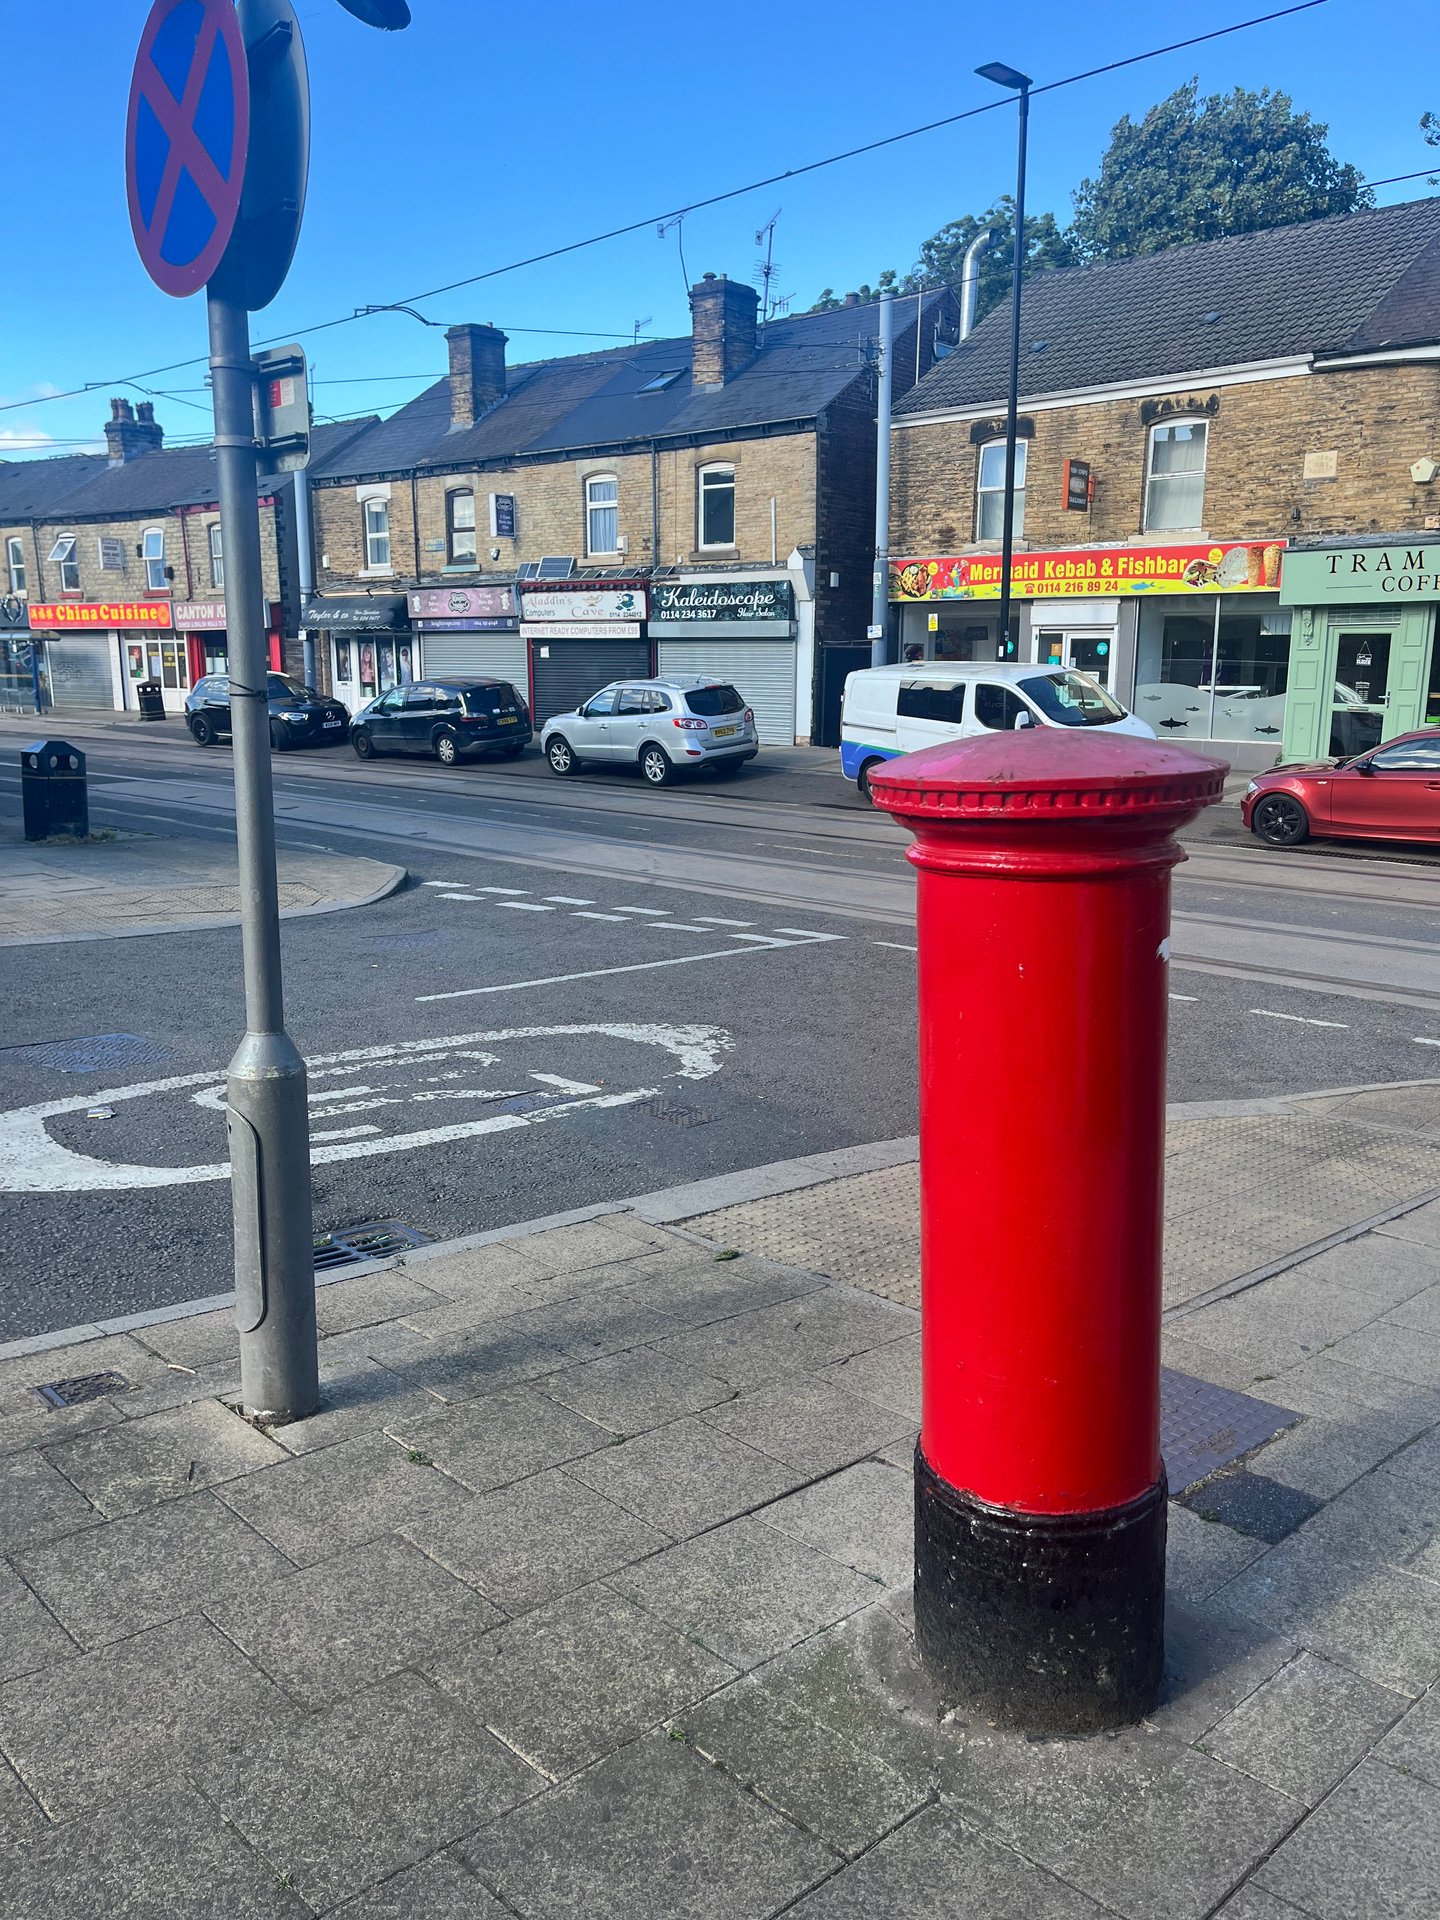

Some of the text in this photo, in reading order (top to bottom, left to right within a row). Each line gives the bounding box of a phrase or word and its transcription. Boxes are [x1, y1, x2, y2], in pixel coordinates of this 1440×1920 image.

[1045, 559, 1097, 578] Kebab
[1101, 557, 1114, 576] &
[1118, 554, 1188, 576] Fishbar
[1326, 550, 1424, 574] TRAM
[1037, 580, 1118, 594] 0114 216 89 24
[525, 594, 573, 609] Aladdin's
[661, 587, 775, 611] Kaleidoscope
[56, 605, 98, 620] China
[99, 604, 158, 620] Cuisine
[176, 605, 214, 620] CANTON
[308, 610, 331, 621] Taylor
[333, 610, 340, 619] &
[525, 608, 556, 617] Computers
[571, 606, 604, 618] Cave
[661, 610, 716, 619] 0114 234 3617
[737, 607, 775, 617] Hair Salon
[521, 626, 638, 635] INTERNET READY COMPUTERS FROM £99
